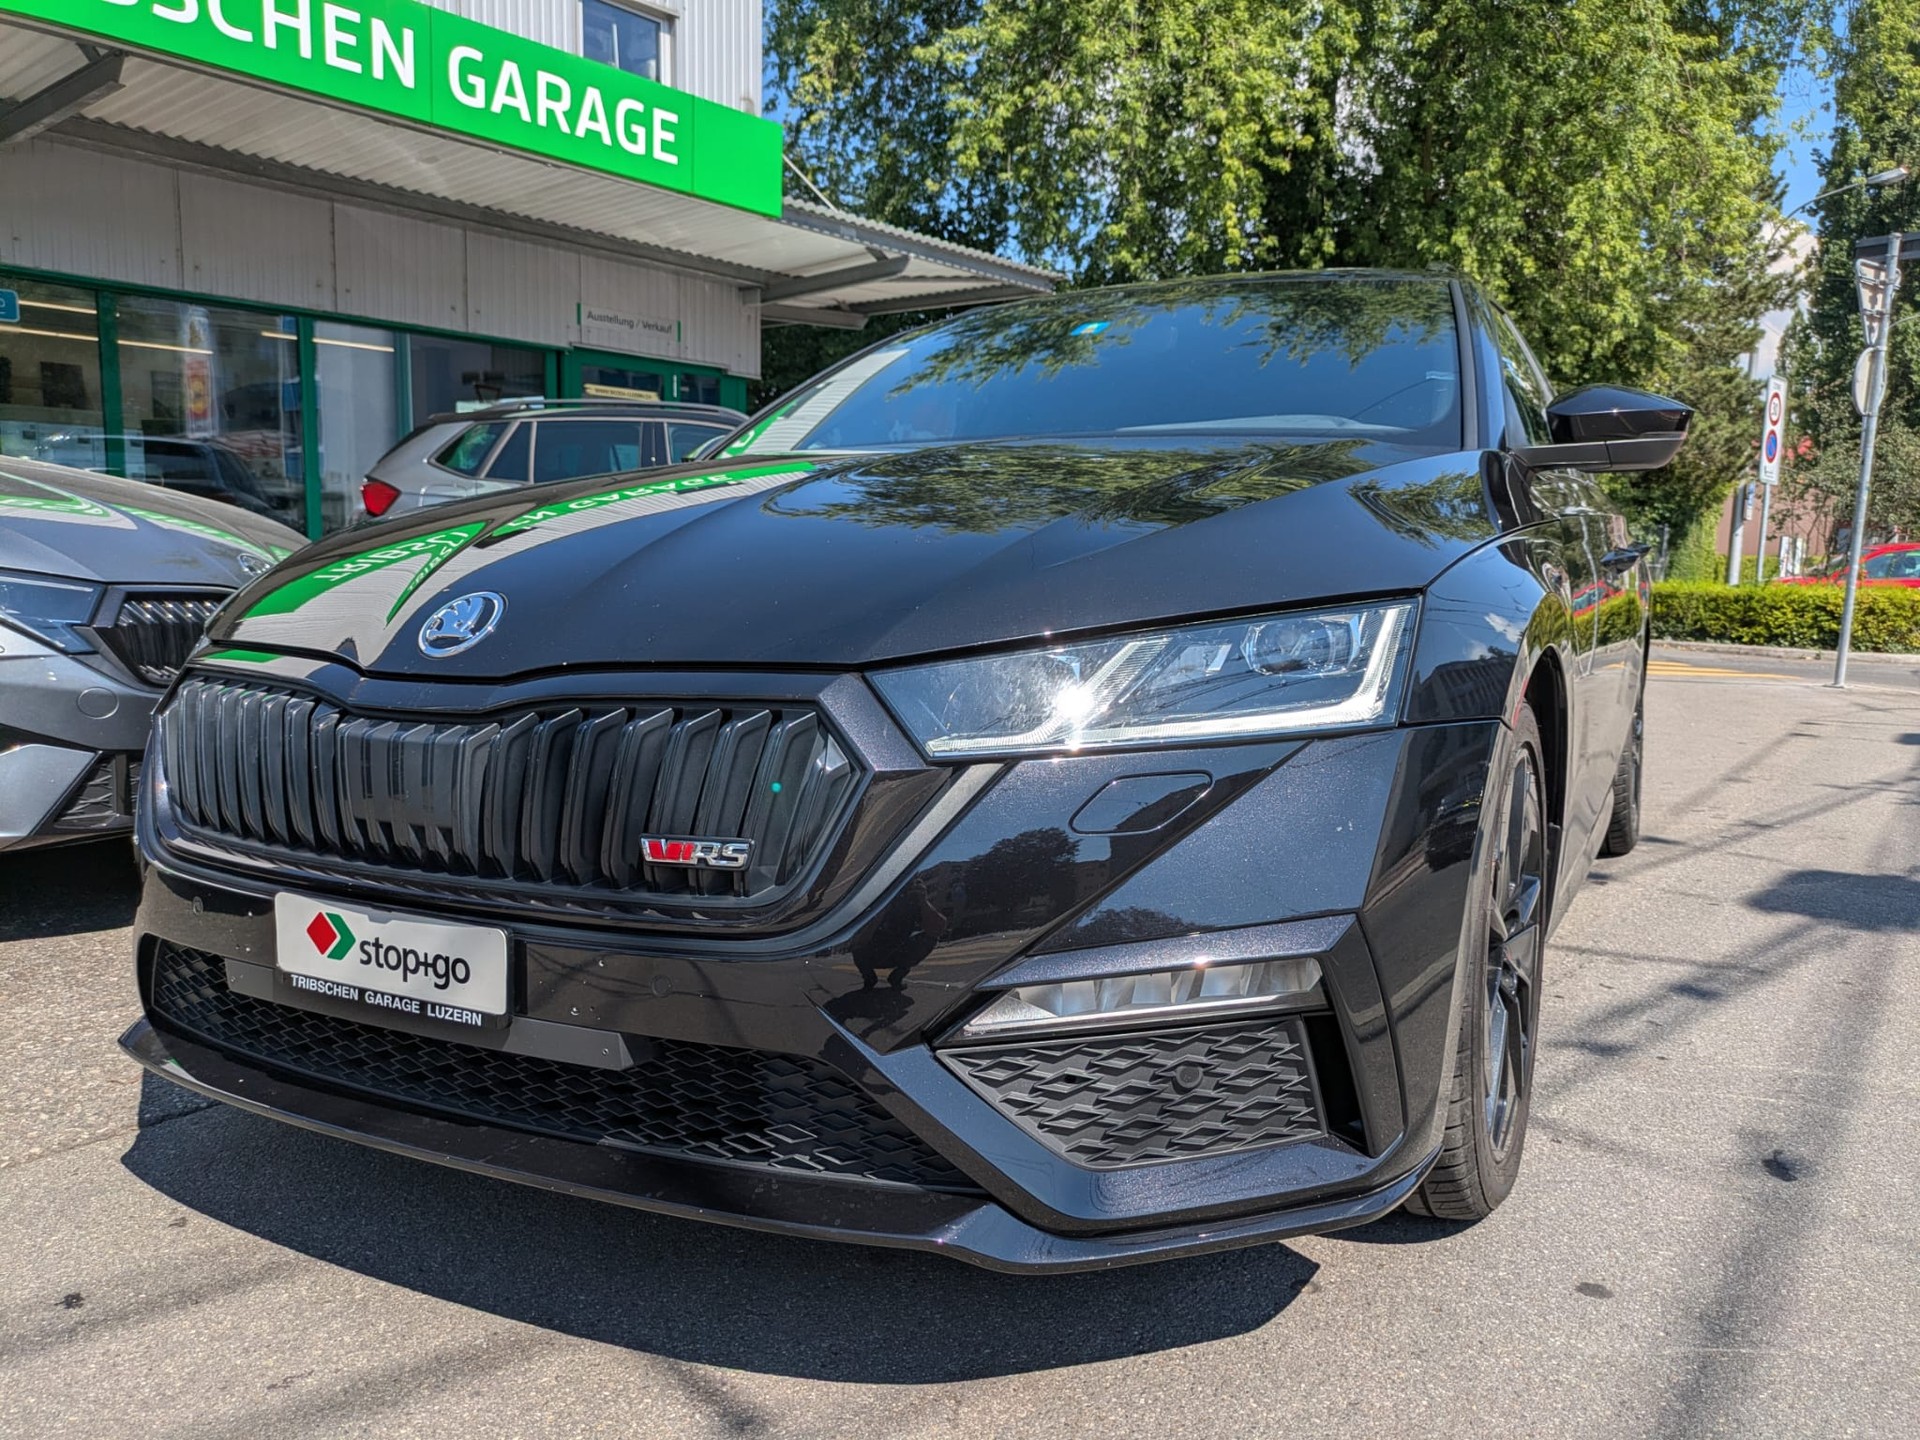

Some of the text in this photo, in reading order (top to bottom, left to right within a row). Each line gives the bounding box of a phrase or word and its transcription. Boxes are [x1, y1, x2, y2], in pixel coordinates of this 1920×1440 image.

[105, 0, 679, 165] CHEN GARAGE
[587, 310, 635, 330] Ausstellung
[641, 320, 672, 334] Verkauf
[359, 937, 471, 990] stop+go
[291, 974, 483, 1027] TRIBSCHEN GARAGE LUZERN
